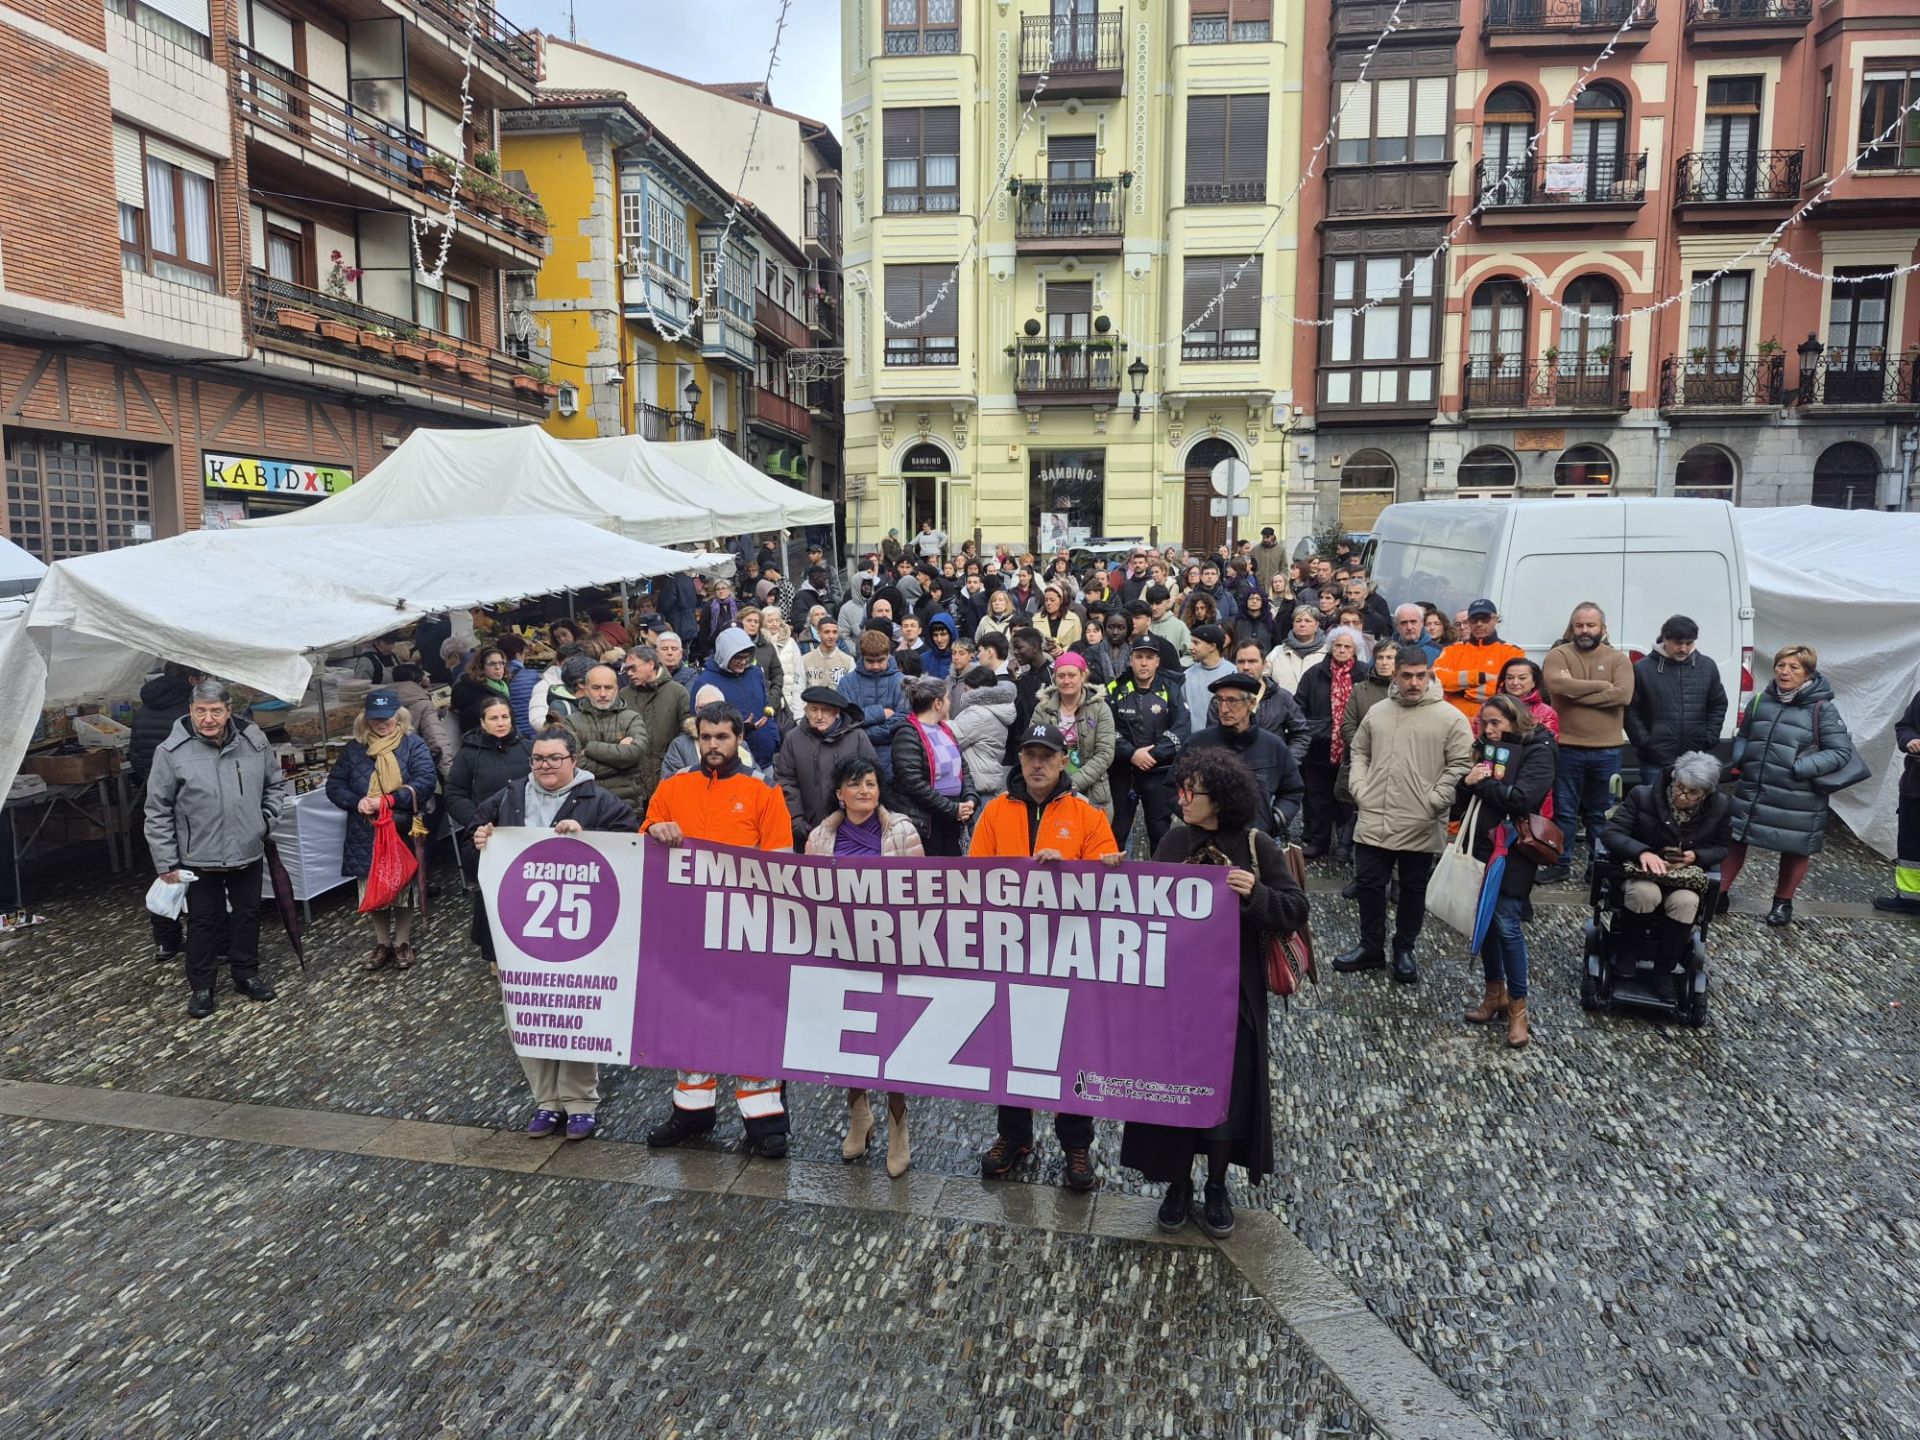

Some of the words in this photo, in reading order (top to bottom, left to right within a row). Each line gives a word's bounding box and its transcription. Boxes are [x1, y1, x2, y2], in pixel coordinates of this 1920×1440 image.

[911, 457, 941, 465] BAMBINO
[209, 460, 335, 493] KABIDXE
[1040, 467, 1093, 481] BAMBINO
[523, 862, 601, 883] azaroak
[667, 848, 1213, 919] EMAKUMEENGANAKO
[522, 881, 592, 940] 25
[505, 990, 602, 1010] INDARKERIAREN
[516, 1012, 584, 1030] KONTRAKO
[782, 965, 1069, 1100] EZ!
[571, 1036, 613, 1052] EGUNA
